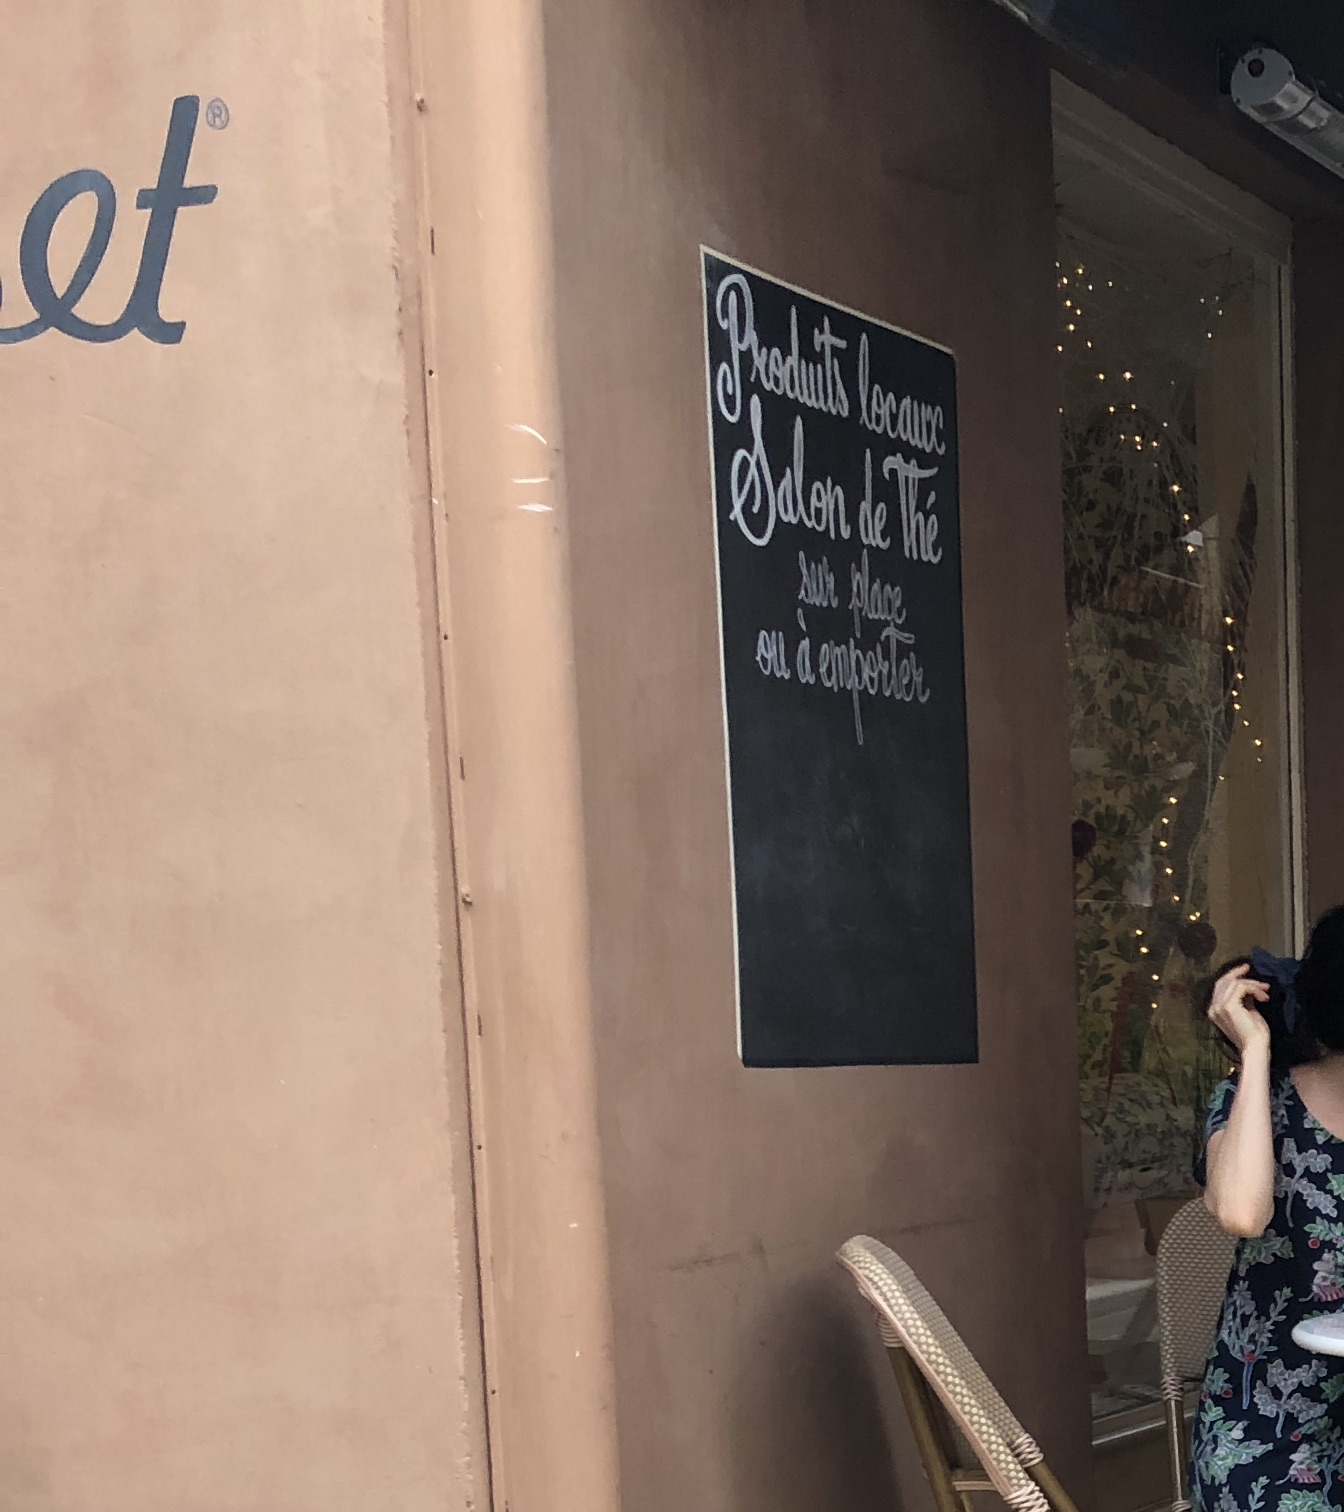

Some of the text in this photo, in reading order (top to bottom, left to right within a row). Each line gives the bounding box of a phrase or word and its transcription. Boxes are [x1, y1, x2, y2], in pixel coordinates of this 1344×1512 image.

[715, 273, 947, 456] Produits locaux
[728, 394, 942, 565] Salon de Thé
[797, 547, 907, 638] sur place
[755, 628, 791, 680] ou
[819, 626, 931, 746] emporter
